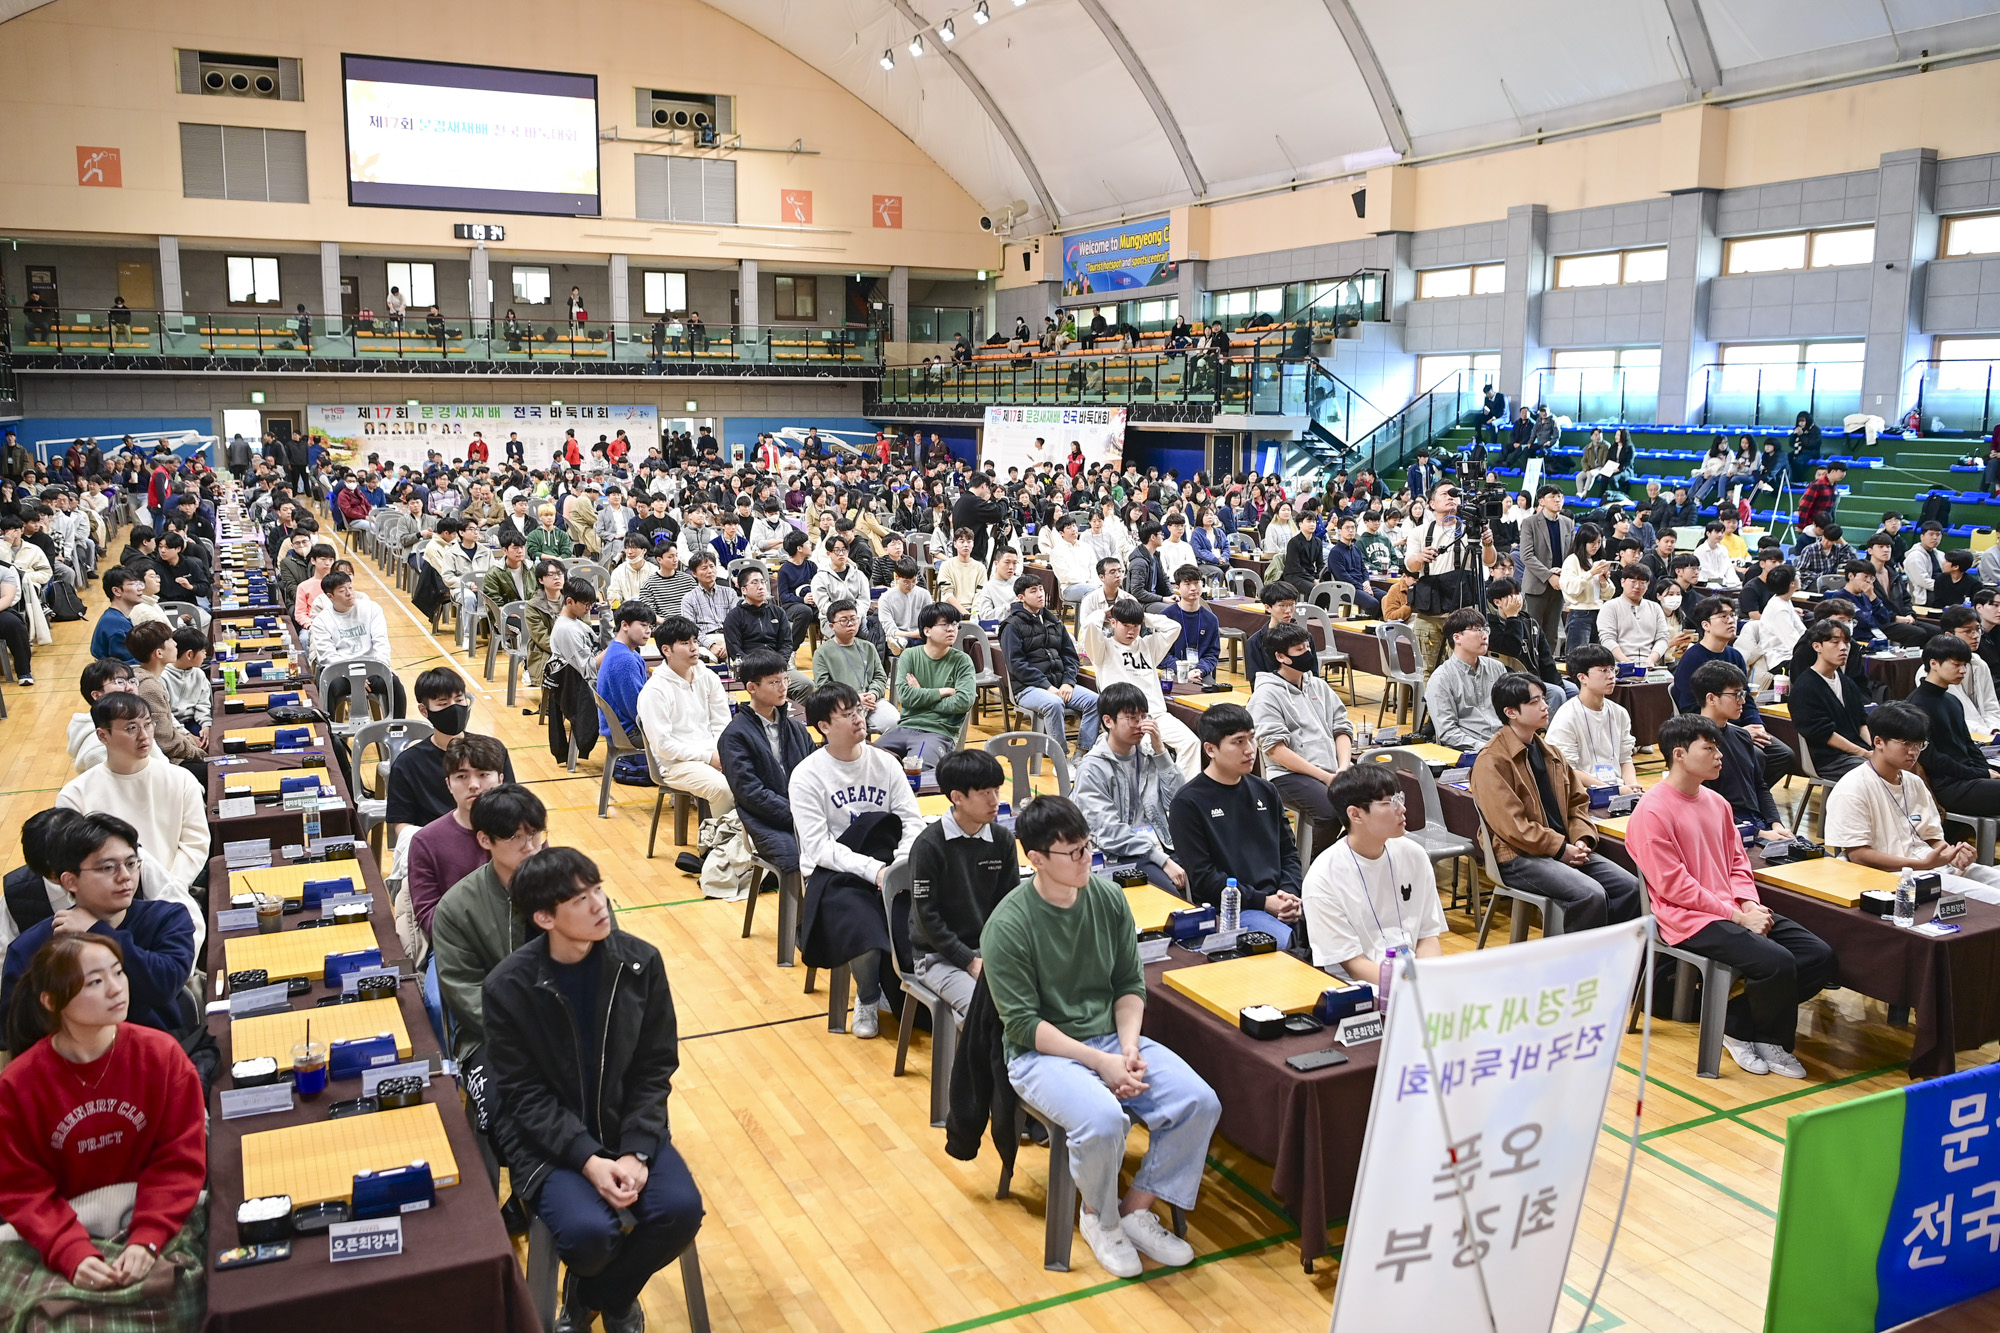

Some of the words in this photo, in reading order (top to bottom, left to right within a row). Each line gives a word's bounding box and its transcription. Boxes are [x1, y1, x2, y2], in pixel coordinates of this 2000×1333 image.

[369, 114, 414, 131] 제17회
[1080, 240, 1109, 256] Welcome
[1110, 237, 1119, 253] to
[1120, 230, 1162, 250] Mungyeong
[1103, 258, 1122, 272] hotspot
[1121, 257, 1131, 268] and
[1131, 255, 1148, 267] sports
[357, 406, 409, 419] 제17회
[421, 406, 502, 420] 문경새재배
[513, 406, 543, 420] 전국
[549, 406, 609, 420] 바둑대회
[1003, 409, 1024, 423] 제17회
[1026, 409, 1061, 424] 문경새재배
[1063, 410, 1078, 425] 전국
[1079, 410, 1110, 425] 바둑대회
[830, 785, 887, 809] CREATE
[1941, 903, 1965, 915] 오픈최강부
[1345, 1022, 1382, 1040] 오픈최강부
[1941, 1093, 2000, 1173] 문
[77, 1131, 124, 1154] PRJCT
[333, 1232, 398, 1253] 오픈최강부
